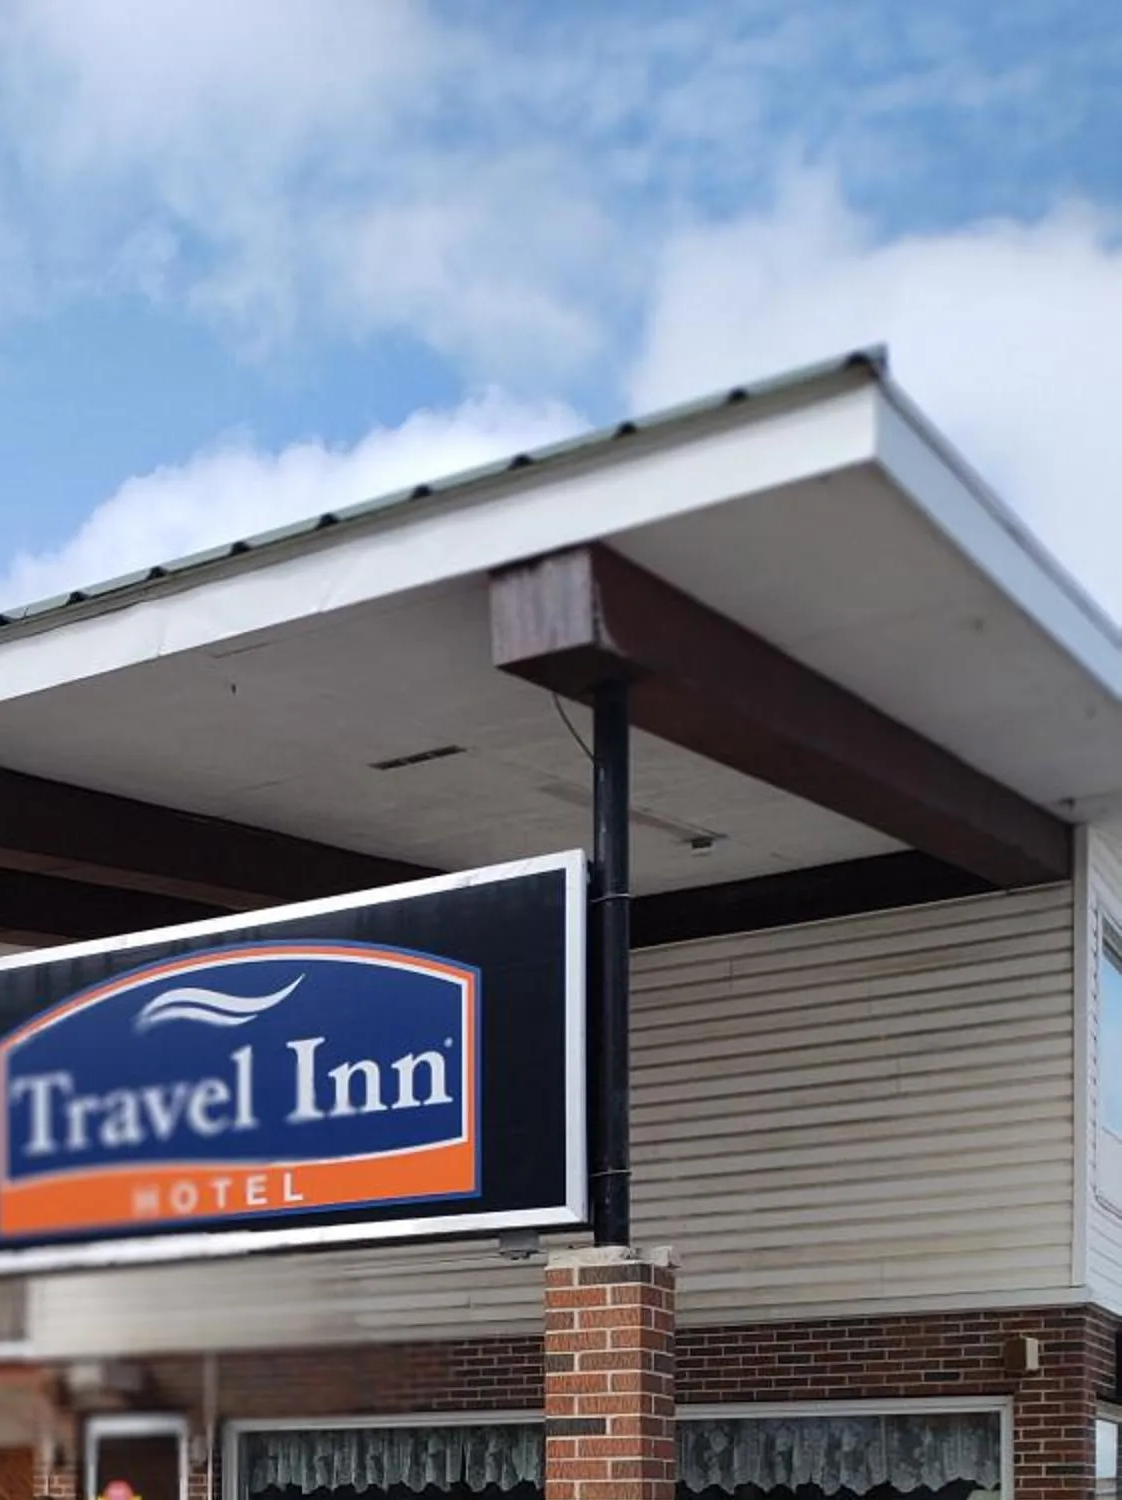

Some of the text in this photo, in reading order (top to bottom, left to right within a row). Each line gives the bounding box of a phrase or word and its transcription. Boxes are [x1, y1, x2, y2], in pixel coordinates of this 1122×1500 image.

[10, 1036, 454, 1156] Travel Inn
[132, 1173, 304, 1218] HOTEL
